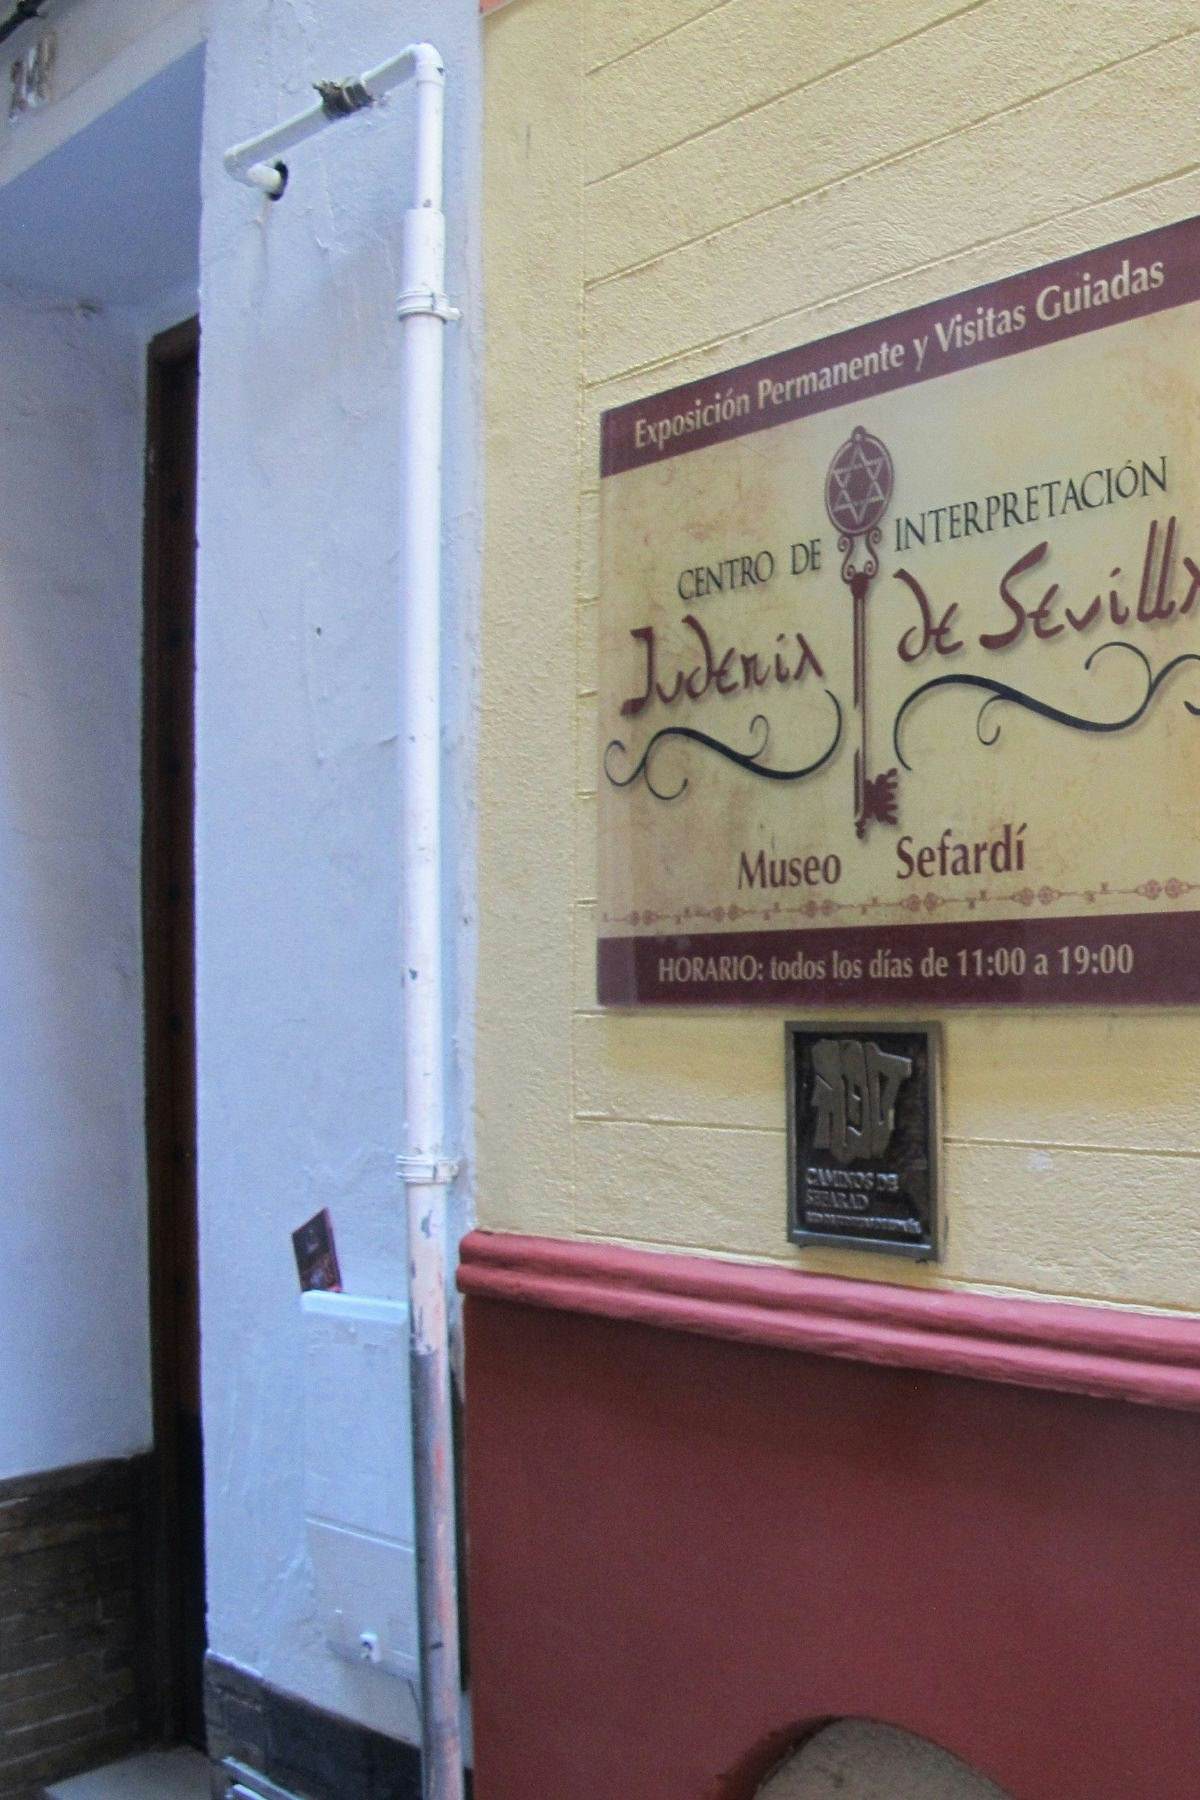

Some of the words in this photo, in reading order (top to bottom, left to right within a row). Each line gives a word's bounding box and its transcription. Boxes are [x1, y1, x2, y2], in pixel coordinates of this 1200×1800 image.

[634, 387, 750, 451] Exposición
[757, 340, 904, 410] Permanente
[912, 334, 929, 373] y
[933, 302, 1027, 353] Visitas
[1035, 259, 1166, 323] Guiadas
[676, 549, 776, 601] CENTRO
[789, 537, 822, 576] DE
[893, 455, 1169, 552] INTERPRETACIÓN
[893, 567, 964, 662] de
[737, 849, 842, 890] Museo
[896, 821, 1028, 880] Sefardí
[657, 955, 764, 983] HORARIO:
[770, 951, 827, 981] todos
[832, 950, 863, 980] los
[868, 948, 914, 979] días
[920, 947, 950, 978] de
[957, 946, 1027, 977] 11:00
[1033, 952, 1049, 977] a
[1058, 943, 1135, 976] 19:00
